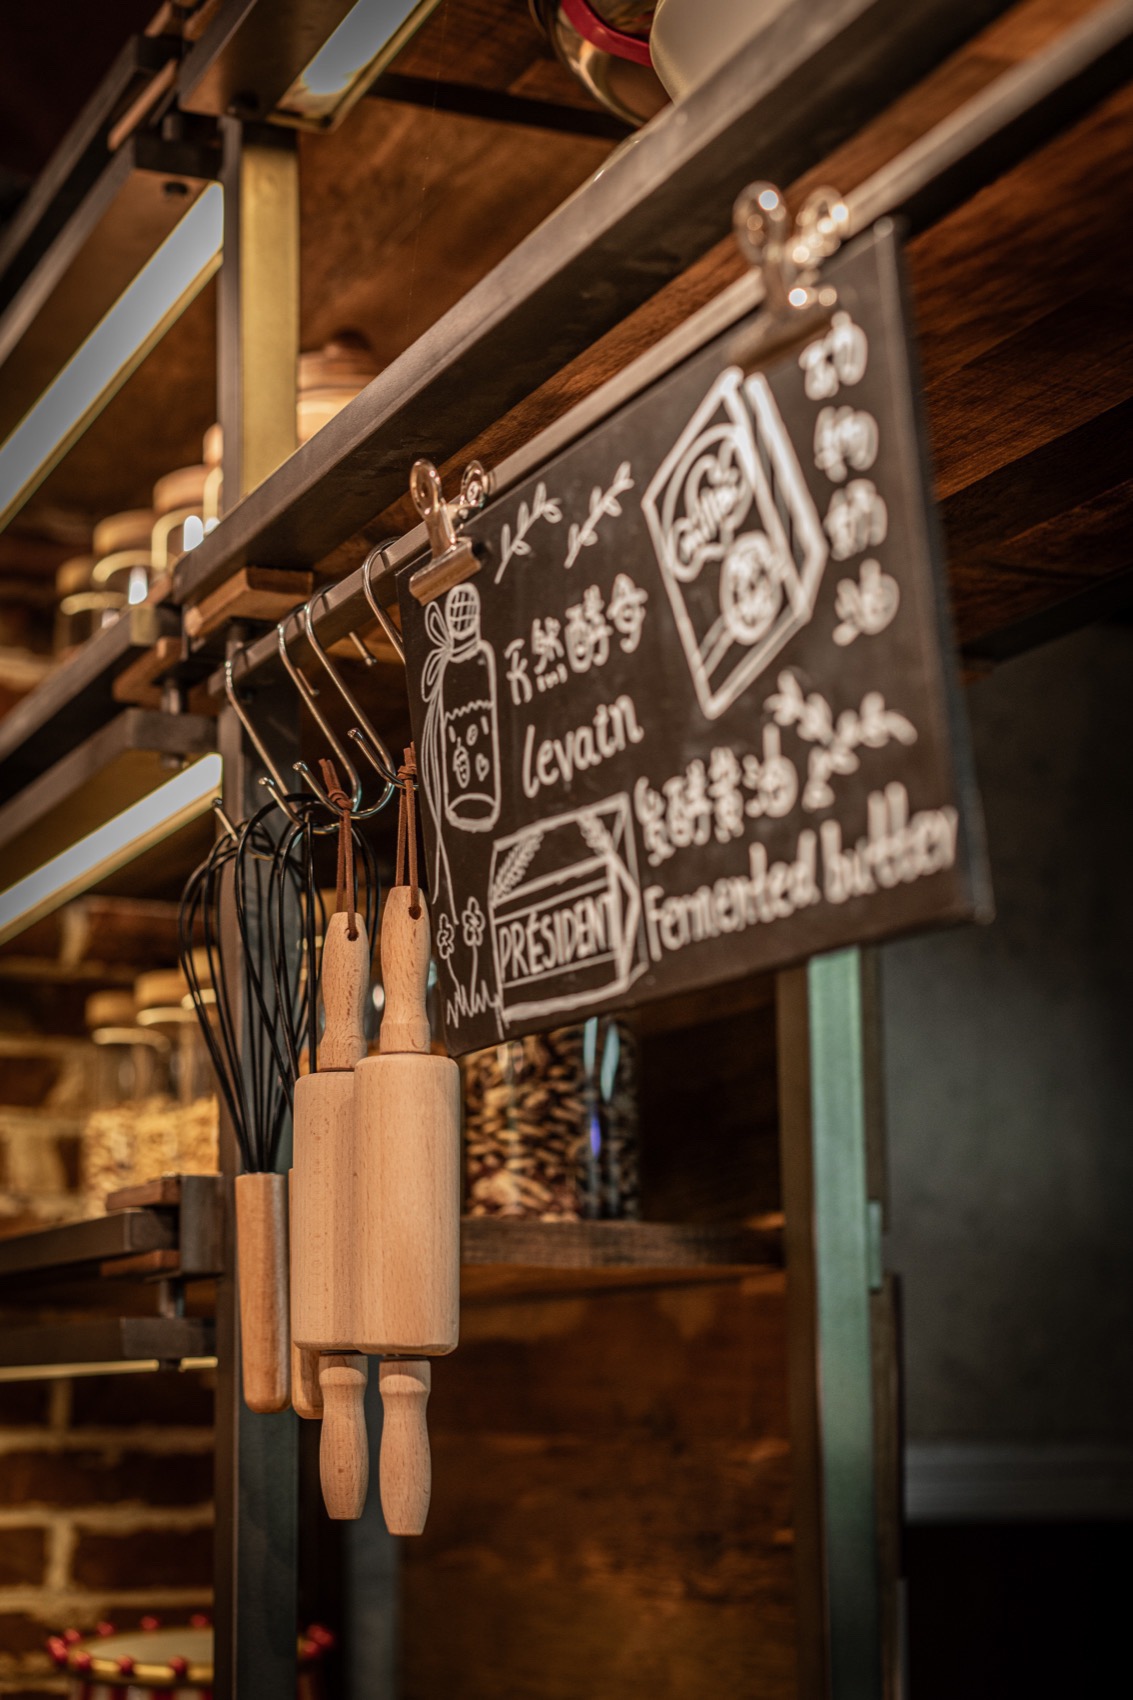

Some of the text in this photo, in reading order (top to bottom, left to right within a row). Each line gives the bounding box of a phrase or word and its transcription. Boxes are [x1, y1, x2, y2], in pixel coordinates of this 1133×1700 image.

[505, 573, 648, 705] 天然酵母
[500, 891, 617, 982] PRÉSIDENT
